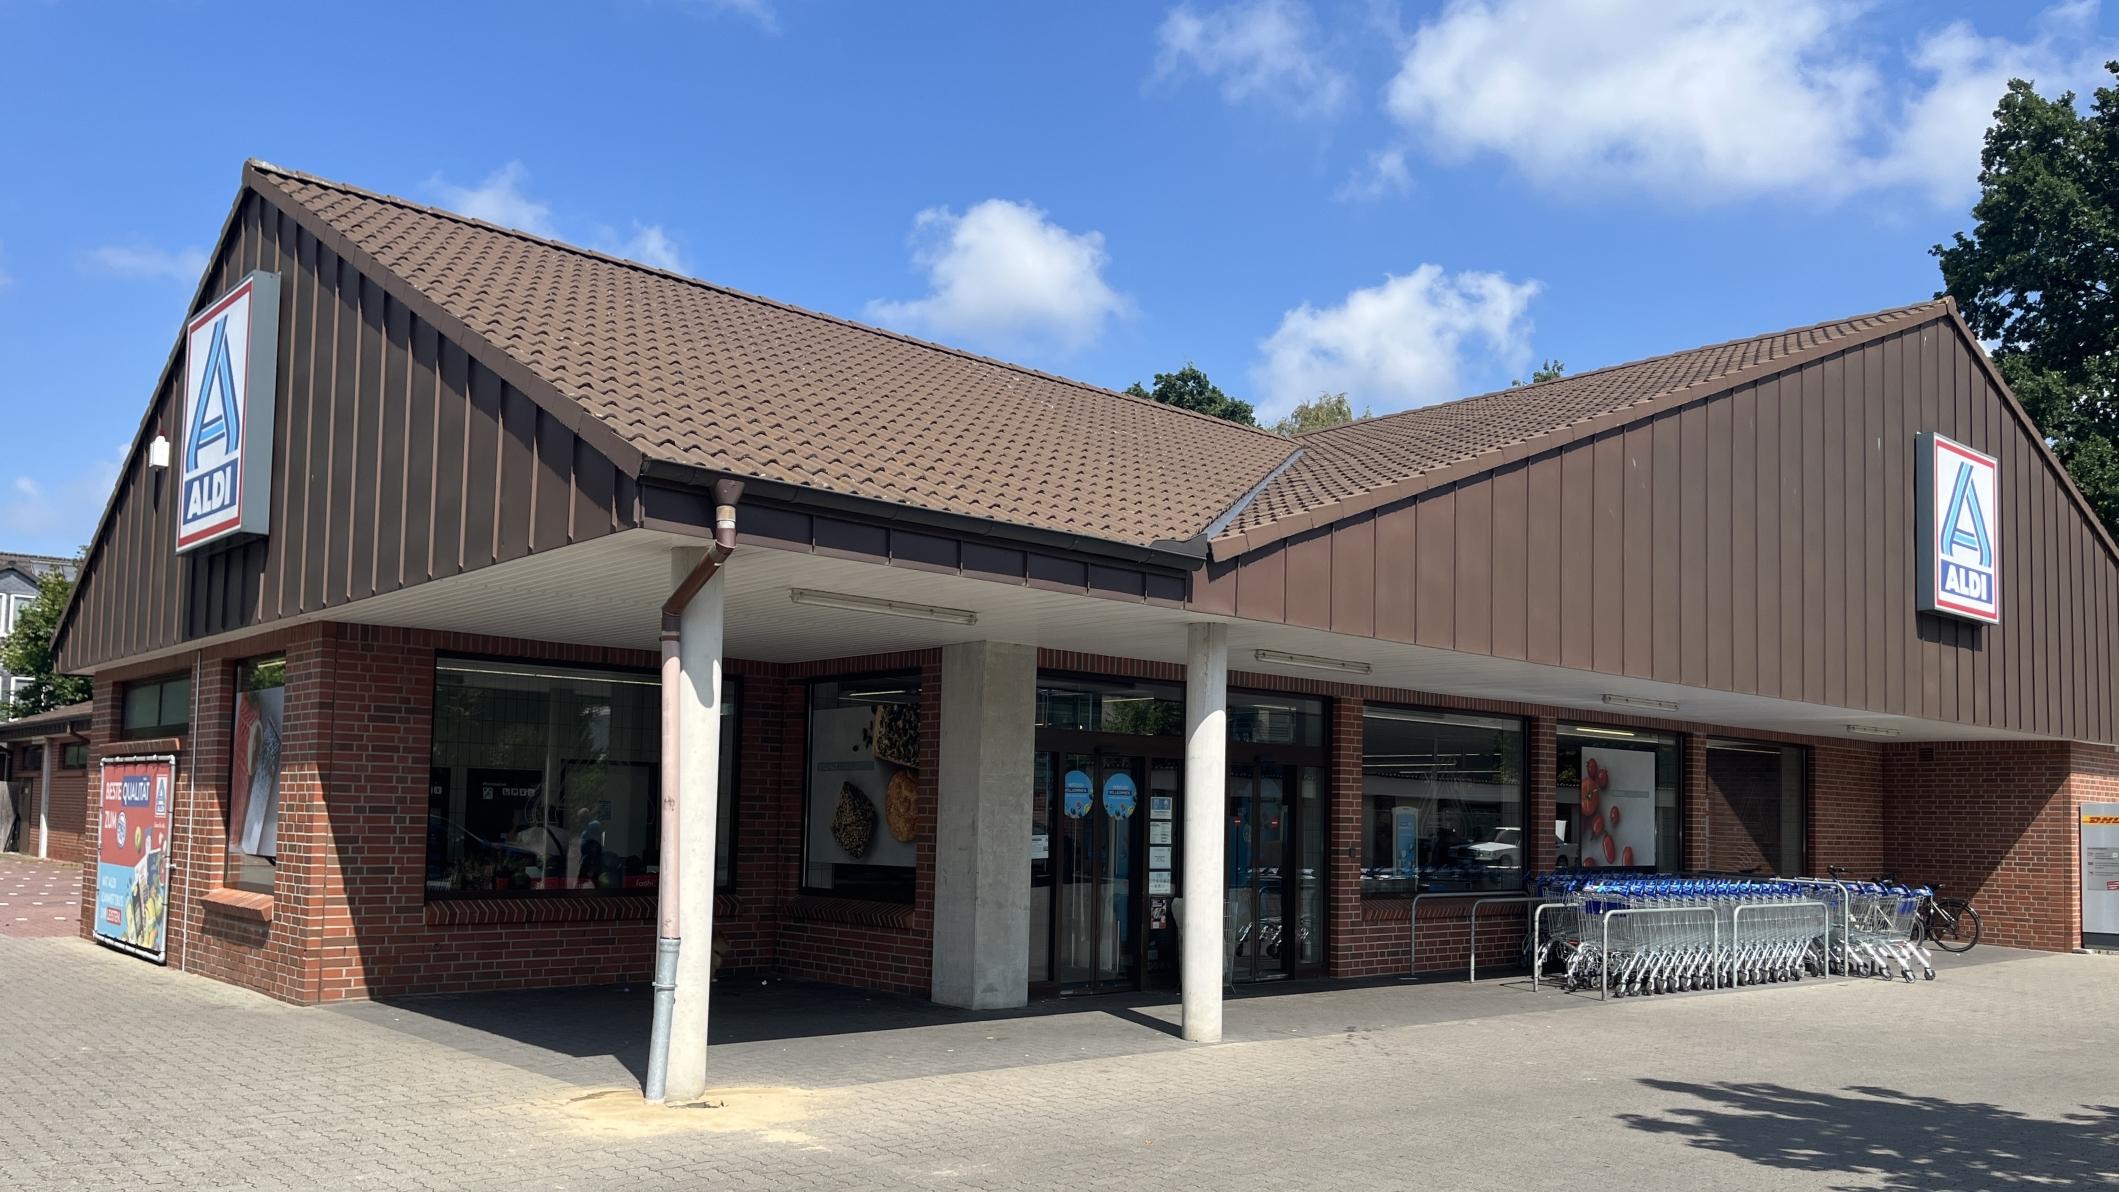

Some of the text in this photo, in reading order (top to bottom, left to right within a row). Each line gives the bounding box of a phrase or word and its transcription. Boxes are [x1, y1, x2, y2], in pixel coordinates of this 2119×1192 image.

[186, 465, 231, 520] ALDI
[1945, 565, 1987, 601] ALDI
[105, 776, 150, 806] BESTE QUALITÄT
[104, 811, 117, 829] ZUM
[2088, 816, 2119, 824] DHL
